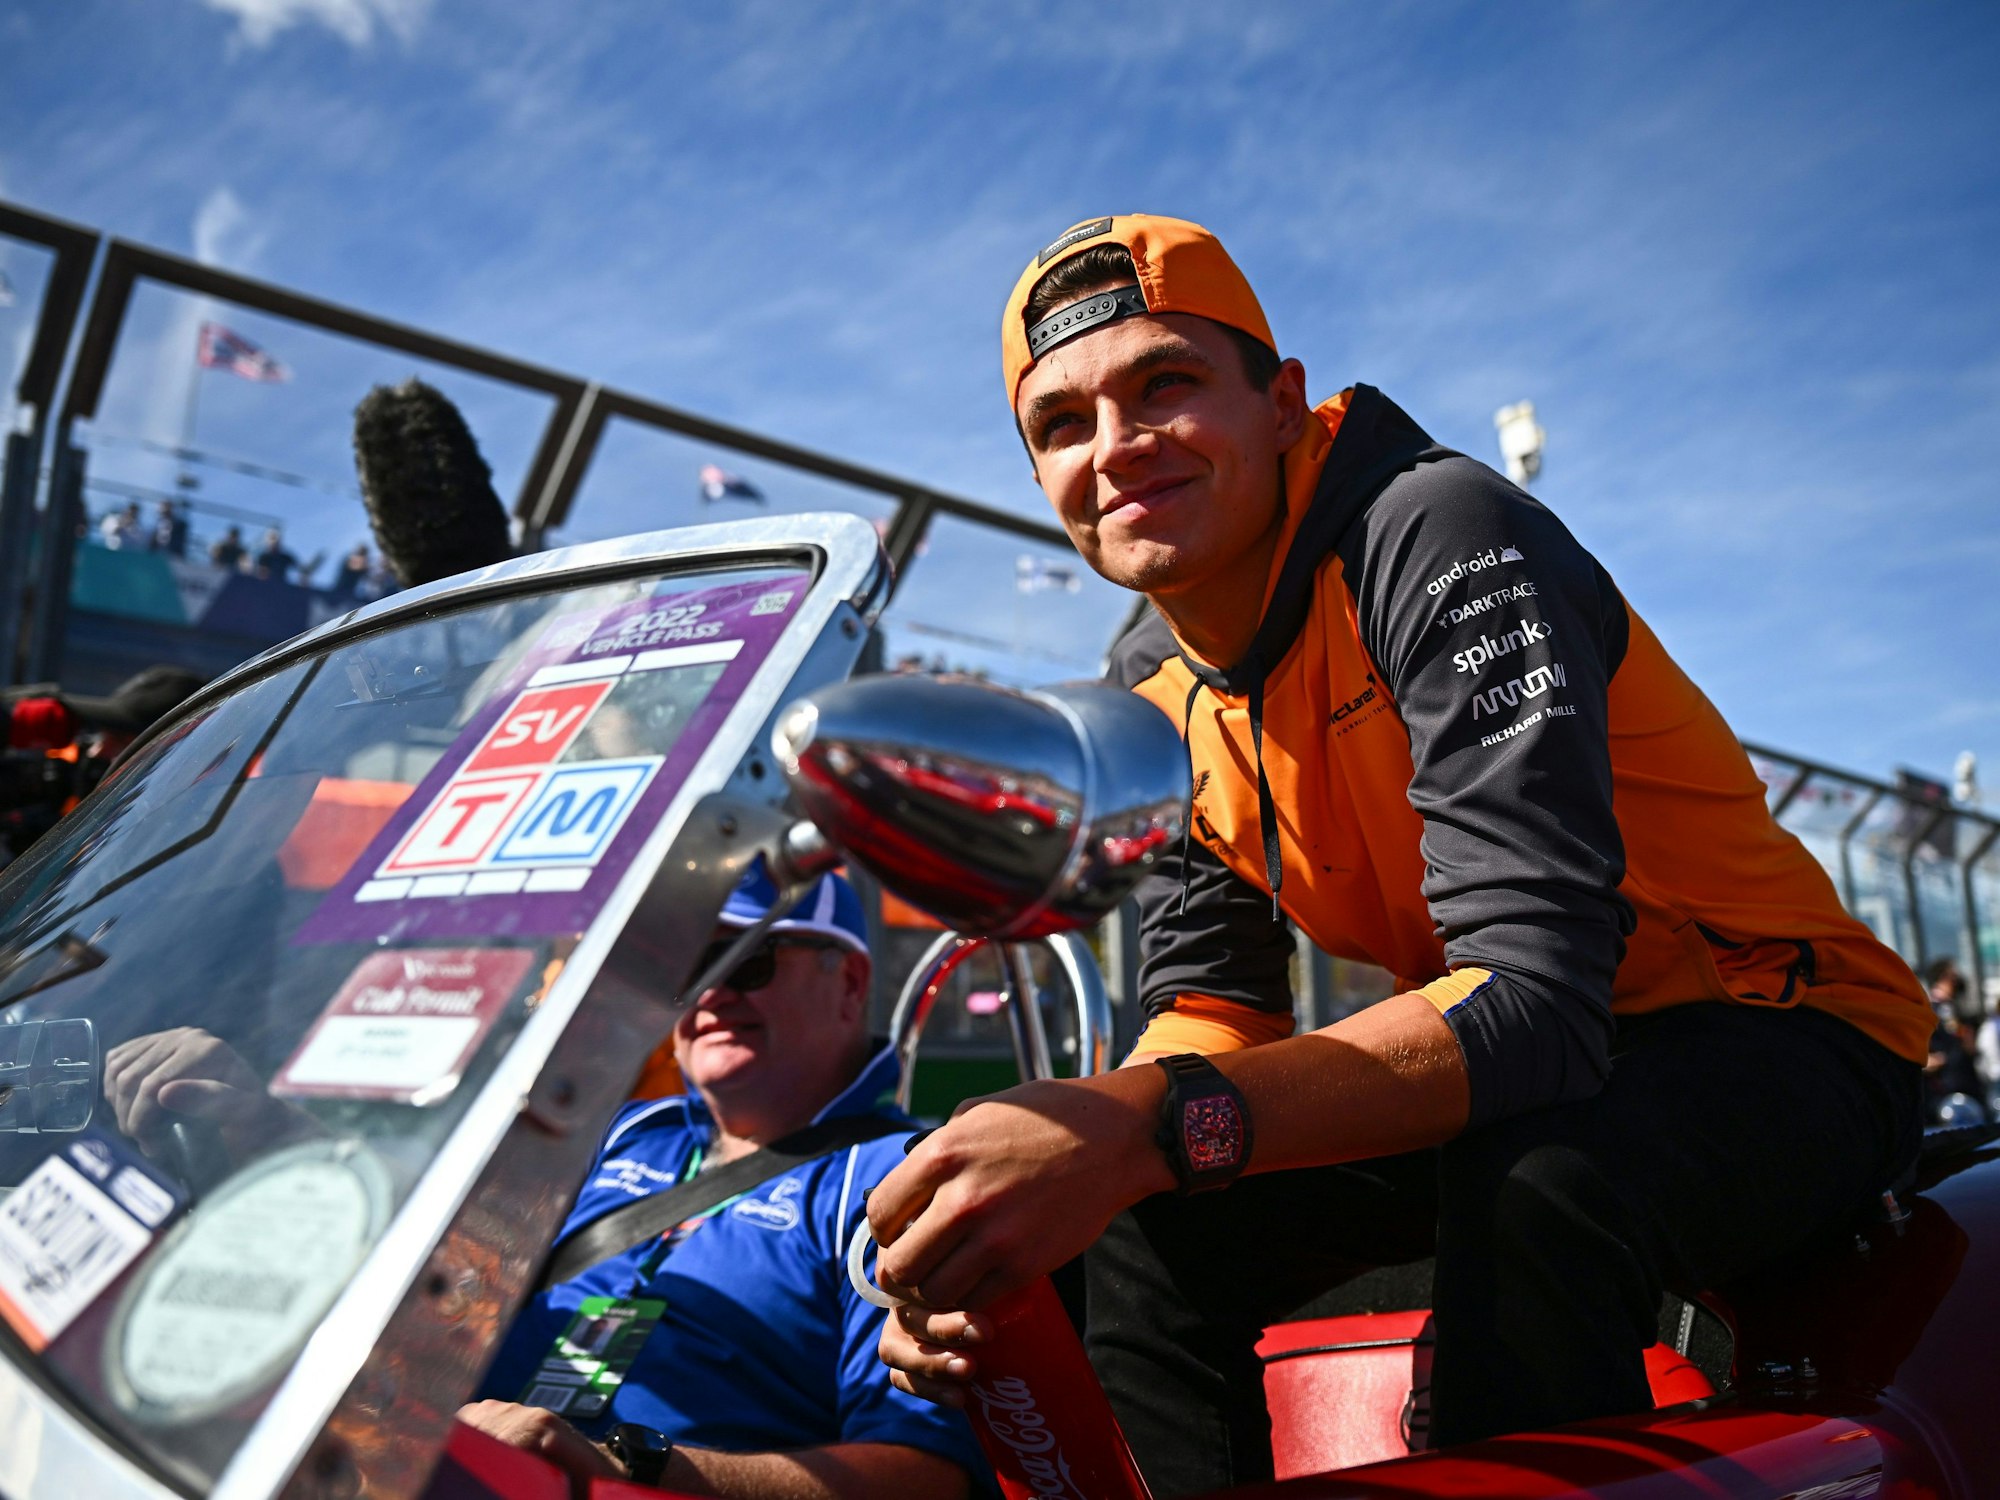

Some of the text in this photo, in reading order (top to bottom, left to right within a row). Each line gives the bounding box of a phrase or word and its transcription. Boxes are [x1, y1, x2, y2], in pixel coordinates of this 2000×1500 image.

[1427, 549, 1498, 595] android
[619, 604, 707, 636] 2022
[1449, 582, 1538, 624] DARKTRACE
[581, 621, 724, 655] VEHICLE PASS
[490, 704, 585, 750] SV
[1480, 705, 1577, 747] RICHARD MILLE
[438, 785, 619, 849] T M
[971, 1376, 1074, 1500] ca-Cola
